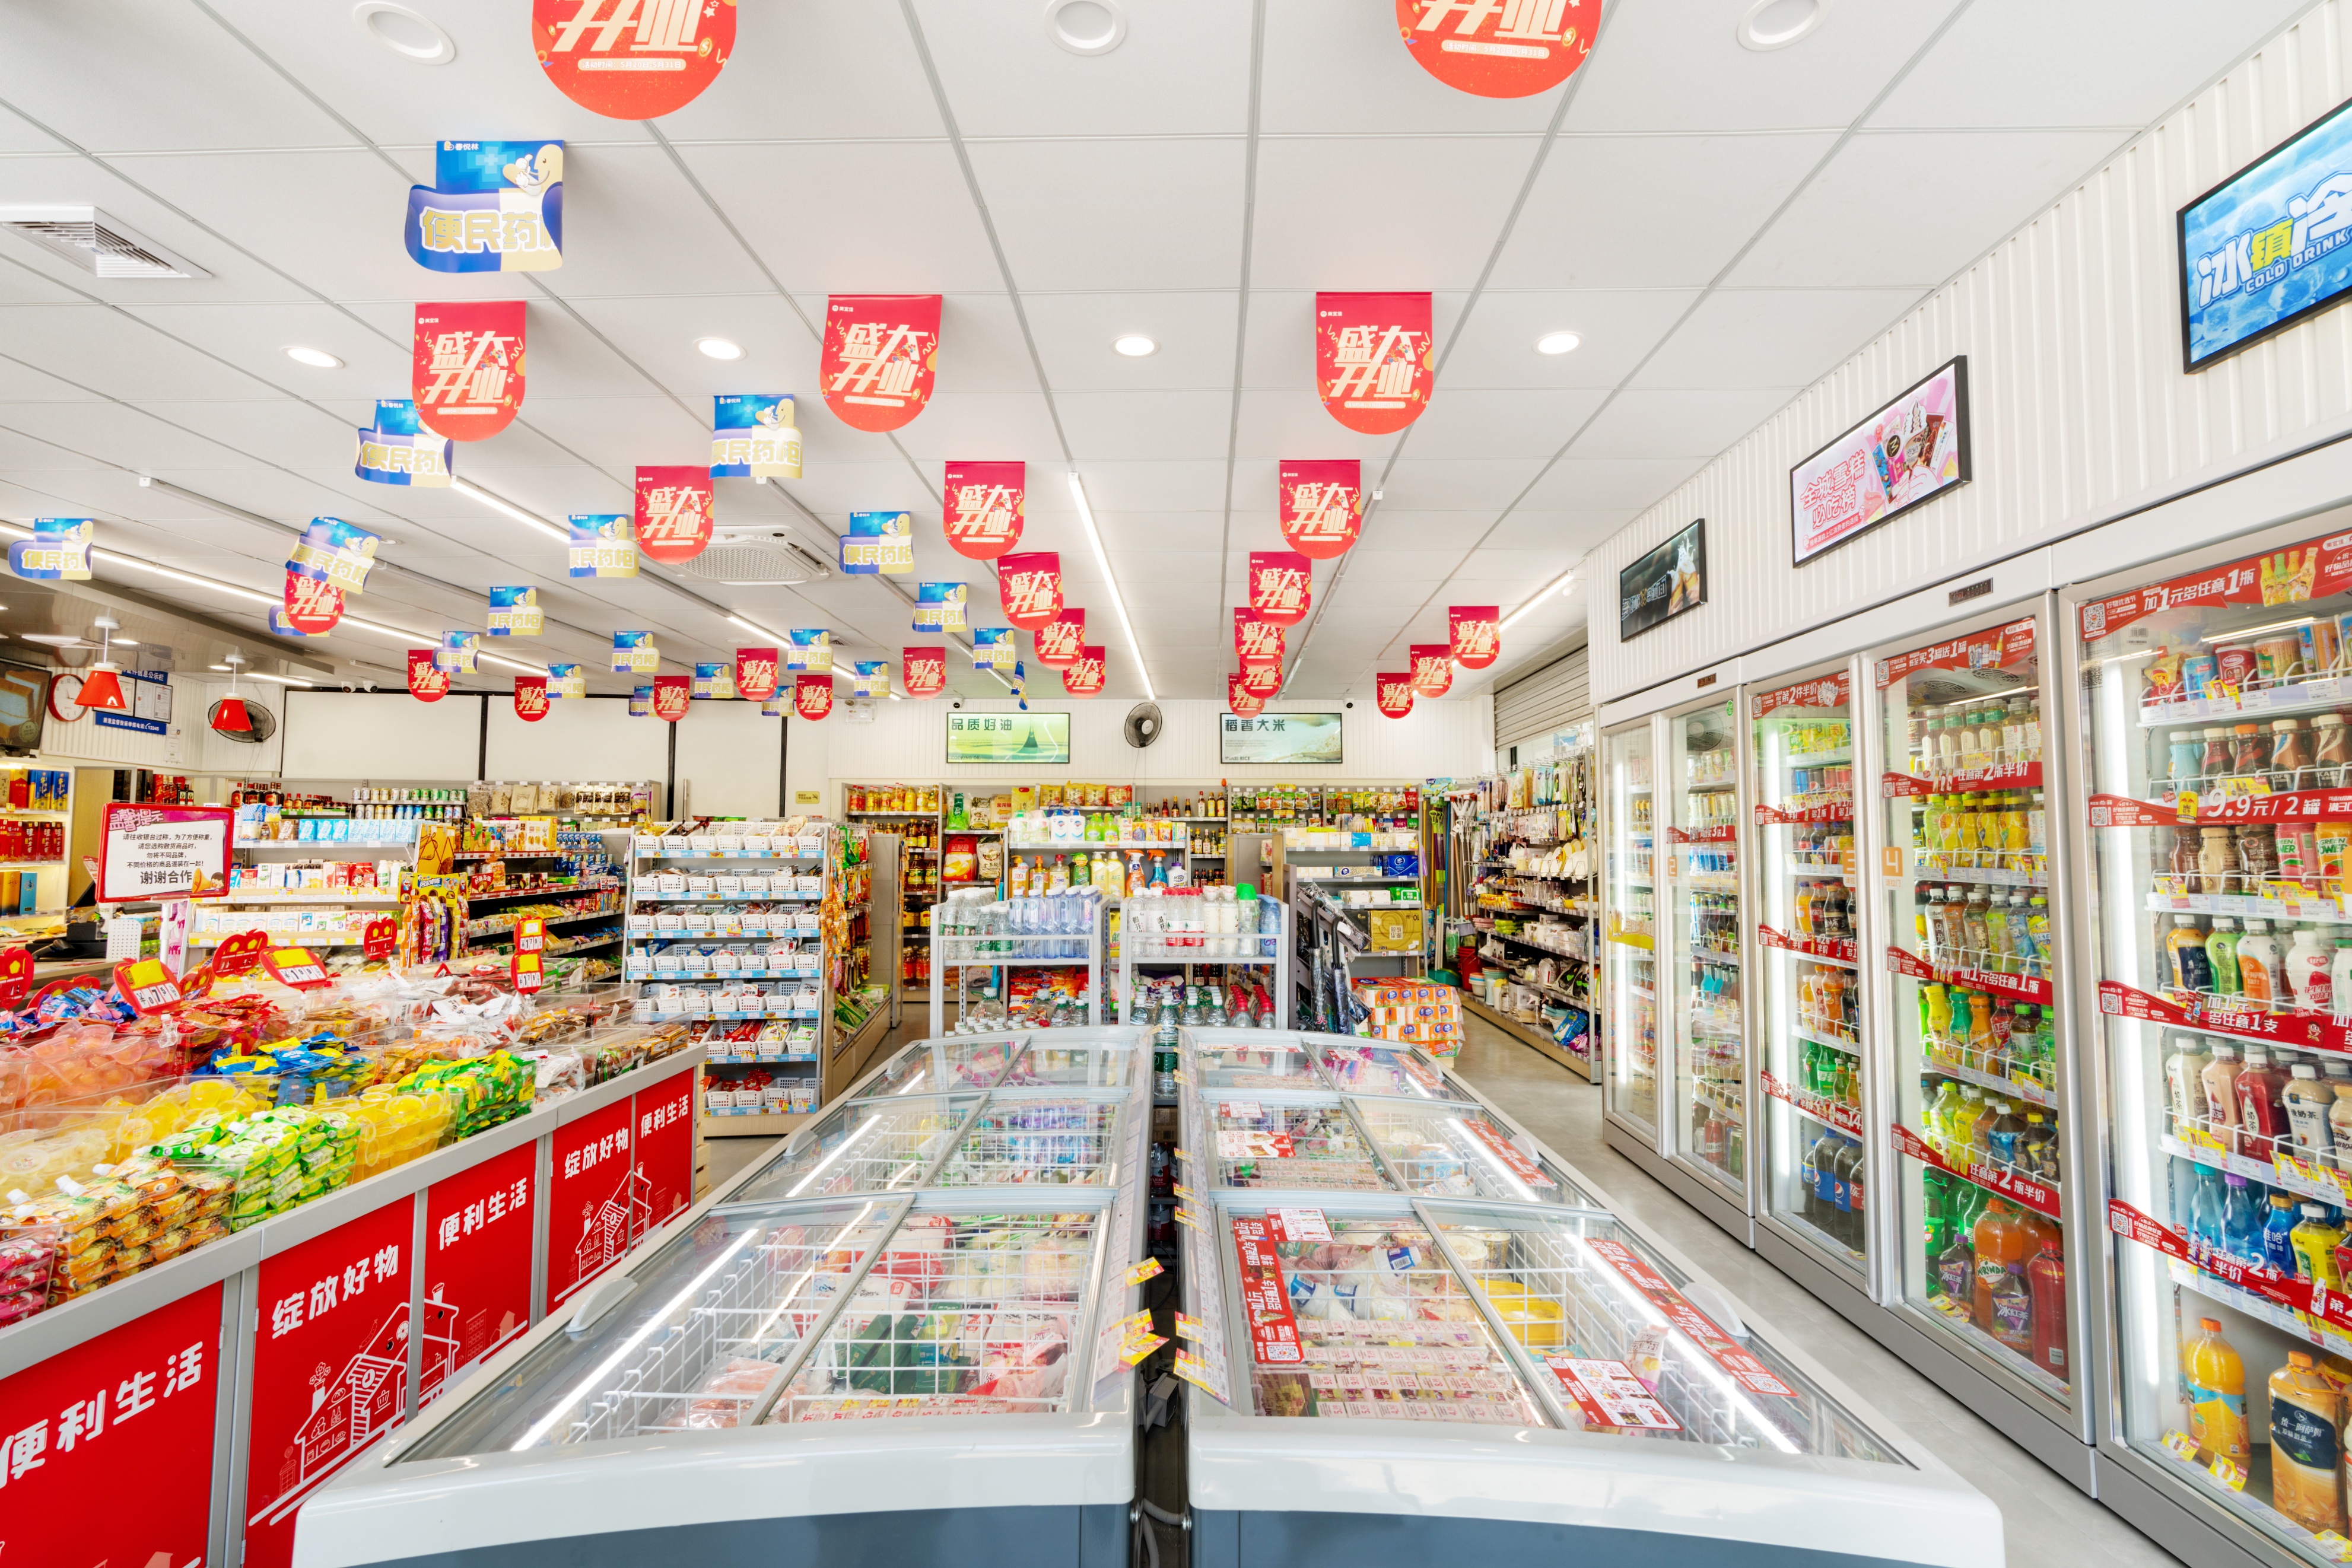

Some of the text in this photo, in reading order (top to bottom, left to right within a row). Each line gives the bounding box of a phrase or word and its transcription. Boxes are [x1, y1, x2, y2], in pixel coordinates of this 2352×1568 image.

[552, 0, 699, 52] 开业
[2245, 231, 2347, 294] COLD DRINK
[429, 331, 515, 370] 盛大
[839, 323, 929, 361] 盛大
[1333, 325, 1422, 363] 盛大
[423, 367, 507, 404] 开业
[831, 357, 919, 397] 开业
[1329, 361, 1415, 397] 开业
[1800, 449, 1866, 511] 全城雪糕
[646, 486, 705, 515] 盛大
[956, 485, 1017, 511] 盛大
[1292, 483, 1353, 509] 盛大
[1813, 484, 1856, 530] 必吃榜
[642, 513, 701, 539] 开业
[951, 510, 1012, 535] 开业
[1288, 507, 1349, 534] 开业
[1010, 570, 1055, 593] 盛大
[1258, 568, 1305, 589] 盛大
[1256, 587, 1302, 608] 开业
[2144, 568, 2256, 612] 加1元多任意1瓶
[290, 594, 336, 615] 开业
[1009, 590, 1053, 613] 开业
[1457, 621, 1495, 639] 盛大
[1038, 637, 1077, 654] 开业
[1240, 637, 1277, 654] 开业
[1455, 637, 1492, 653] 开业
[437, 652, 474, 667] 便民药
[743, 660, 774, 675] 盛大
[910, 659, 941, 673] 盛大
[1417, 657, 1448, 672] 盛大
[412, 674, 443, 688] 开业
[742, 673, 771, 688] 开业
[909, 672, 939, 687] 开业
[1067, 671, 1098, 686] 开业
[1245, 671, 1276, 685] 开业
[1415, 670, 1446, 685] 开业
[659, 686, 686, 698] 盛大
[802, 685, 829, 699] 盛大
[1382, 683, 1410, 696] 盛大
[1381, 695, 1408, 707] 开业
[951, 718, 1012, 731] 品质好油
[1225, 719, 1285, 731] 稻香大米
[1958, 760, 2029, 782] 任意第2瓶半价
[140, 870, 192, 885] 谢谢合作
[1133, 916, 1144, 933] 喝开
[1960, 962, 2040, 995] 加1元多任意1瓶
[2208, 1010, 2278, 1033] 多任意1支
[640, 1095, 689, 1138] 便利生活
[2246, 1111, 2256, 1133] 奶茶
[564, 1128, 629, 1180] 绽放好物
[1970, 1162, 2046, 1204] 任意第2瓶半价
[438, 1178, 527, 1251] 便利生活
[2214, 1261, 2243, 1283] 半价
[272, 1245, 399, 1339] 绽放好物
[0, 1341, 204, 1489] 便利生活
[2280, 1416, 2322, 1437] 统一阿萨姆
